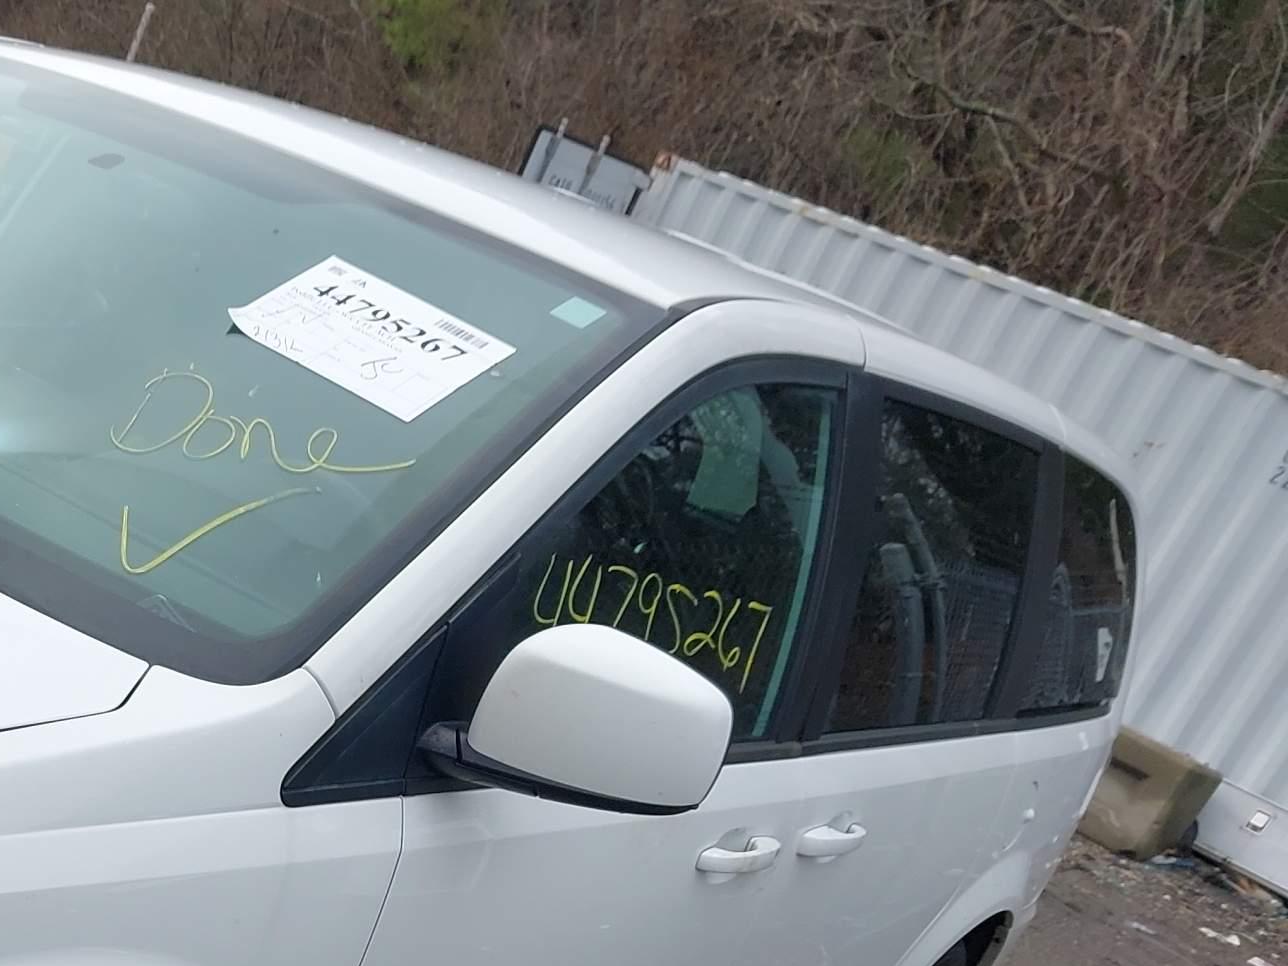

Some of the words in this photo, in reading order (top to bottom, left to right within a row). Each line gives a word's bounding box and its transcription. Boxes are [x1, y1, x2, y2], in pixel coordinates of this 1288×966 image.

[313, 284, 468, 361] 44795267
[110, 368, 417, 473] Done
[533, 553, 773, 695] 44795267
